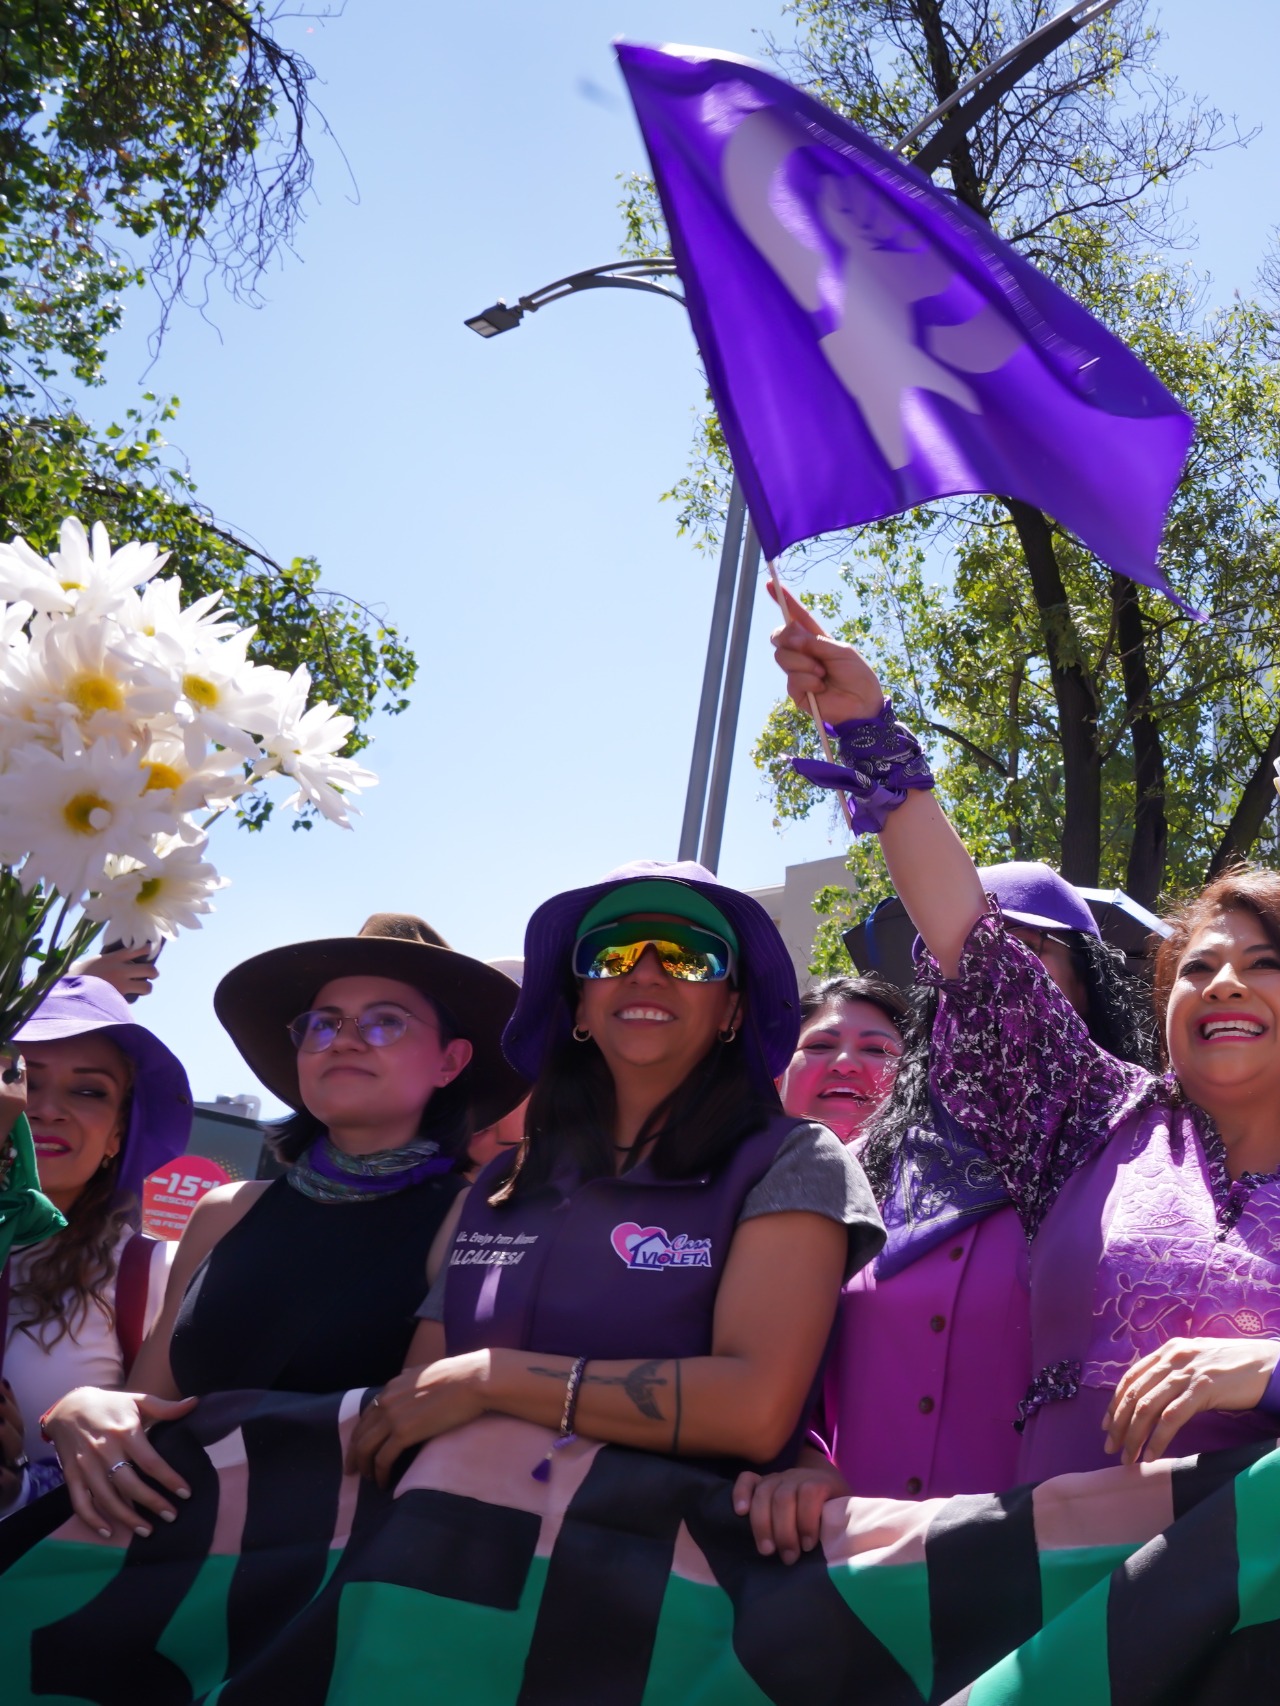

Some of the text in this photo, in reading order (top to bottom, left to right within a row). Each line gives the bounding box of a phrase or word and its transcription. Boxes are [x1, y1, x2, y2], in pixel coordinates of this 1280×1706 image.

[153, 1194, 198, 1208] DESCUE
[162, 1220, 187, 1230] FEBR
[642, 1251, 710, 1266] VIOLETA
